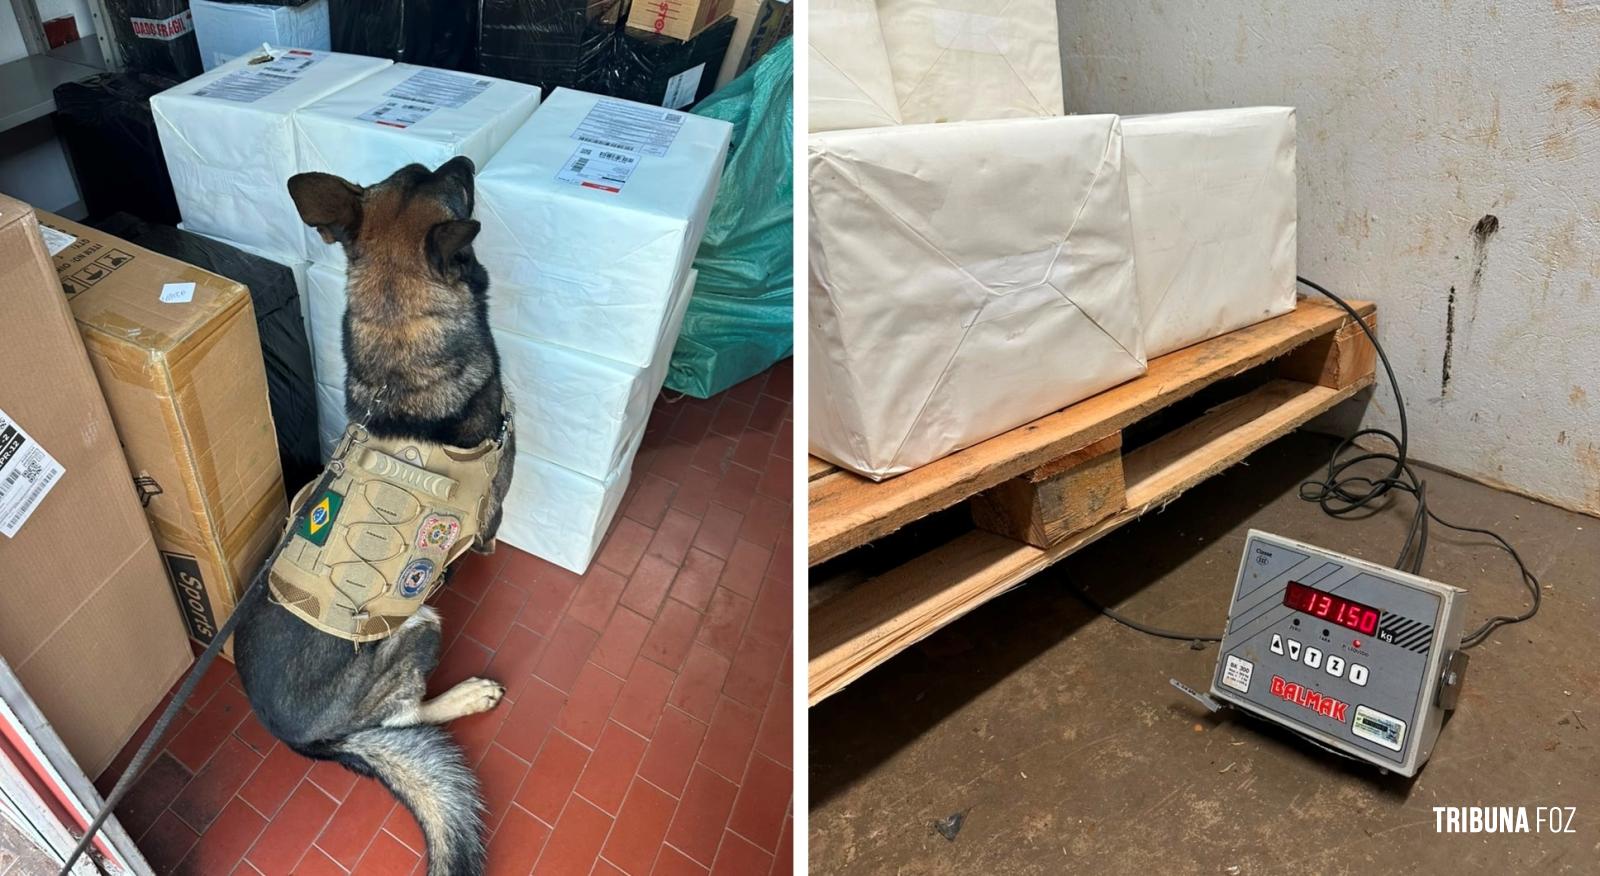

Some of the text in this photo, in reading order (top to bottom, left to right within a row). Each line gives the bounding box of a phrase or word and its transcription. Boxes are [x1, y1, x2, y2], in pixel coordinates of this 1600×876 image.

[0, 440, 20, 468] PR-12
[178, 571, 214, 637] Sports
[1308, 593, 1377, 633] 131.50
[1380, 630, 1393, 643] kg
[1310, 652, 1317, 662] T
[1332, 660, 1340, 671] Z
[1269, 674, 1350, 724] BALMAK
